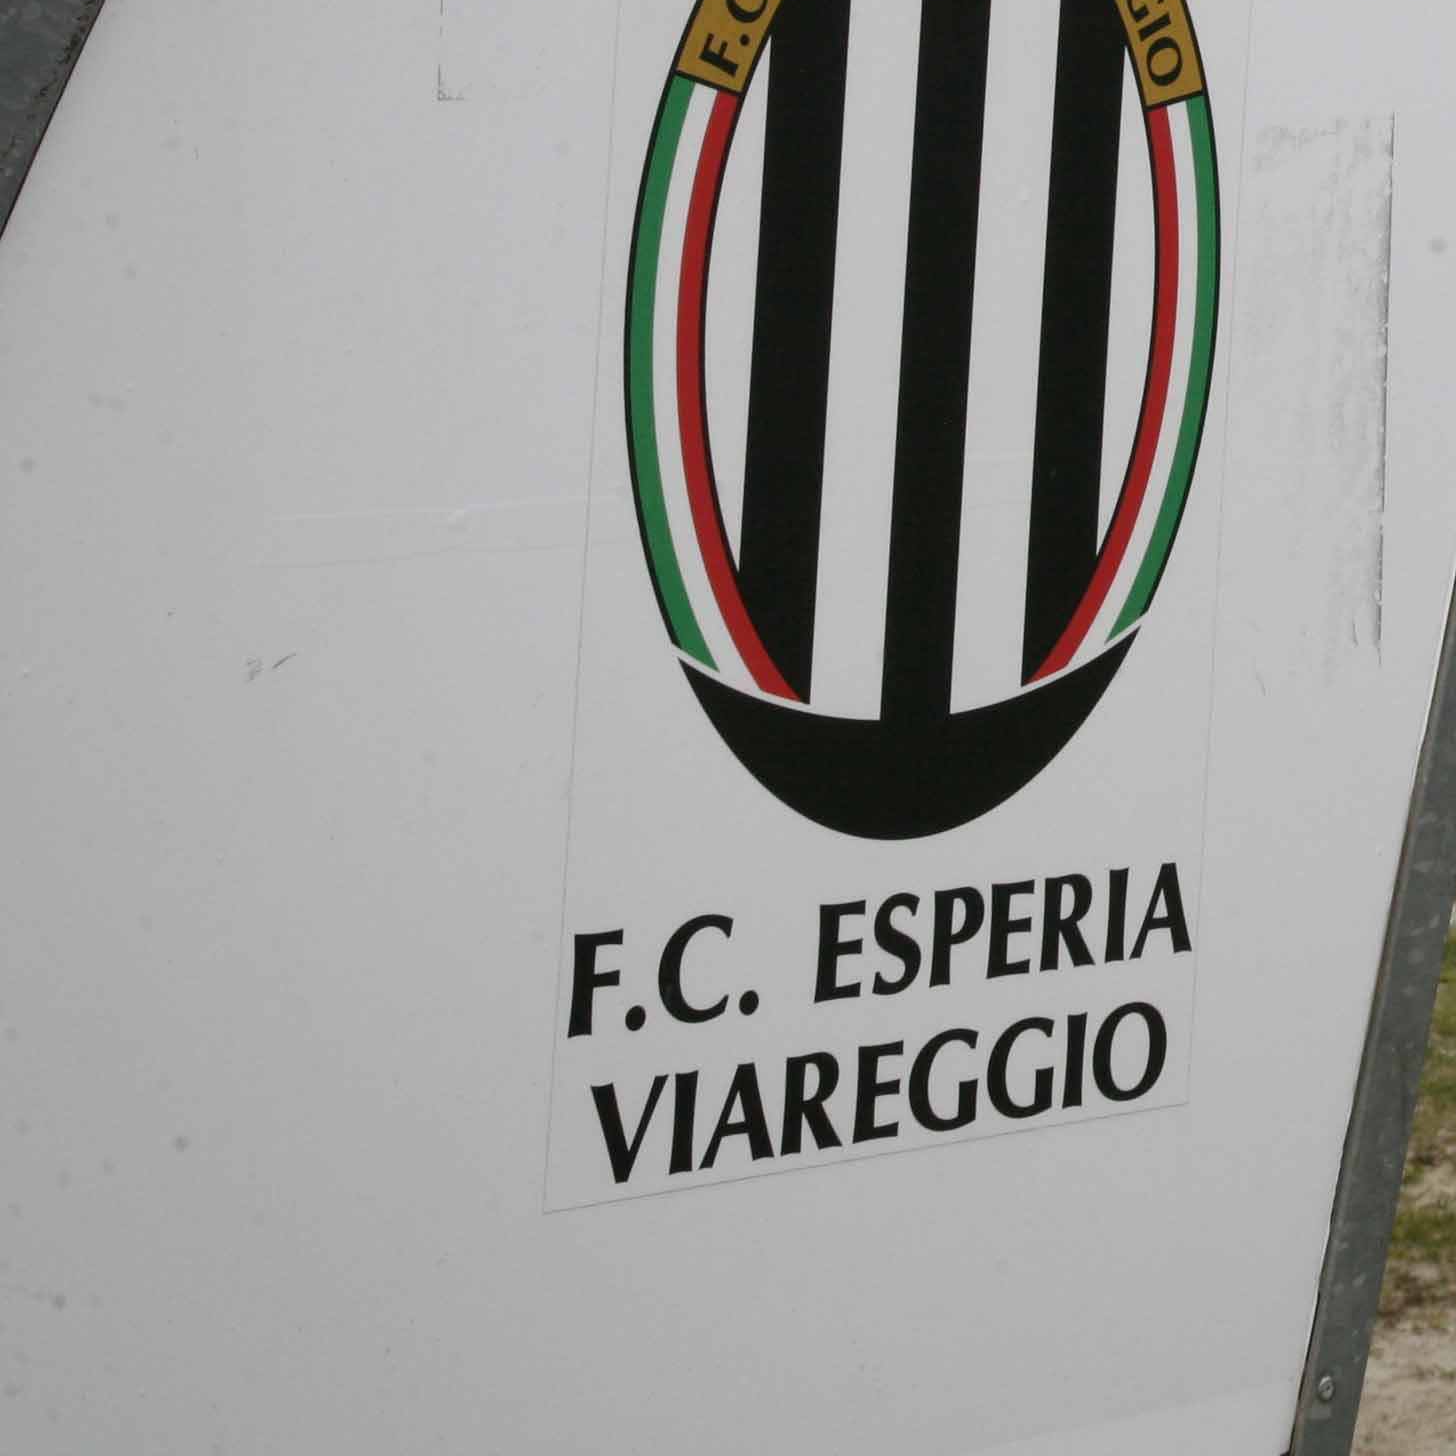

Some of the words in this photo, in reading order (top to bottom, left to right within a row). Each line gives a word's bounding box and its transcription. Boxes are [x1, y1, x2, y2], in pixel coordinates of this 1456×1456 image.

[567, 913, 760, 1038] F.C.
[813, 862, 1192, 1003] ESPERIA
[590, 1001, 1168, 1185] VIAREGGIO
